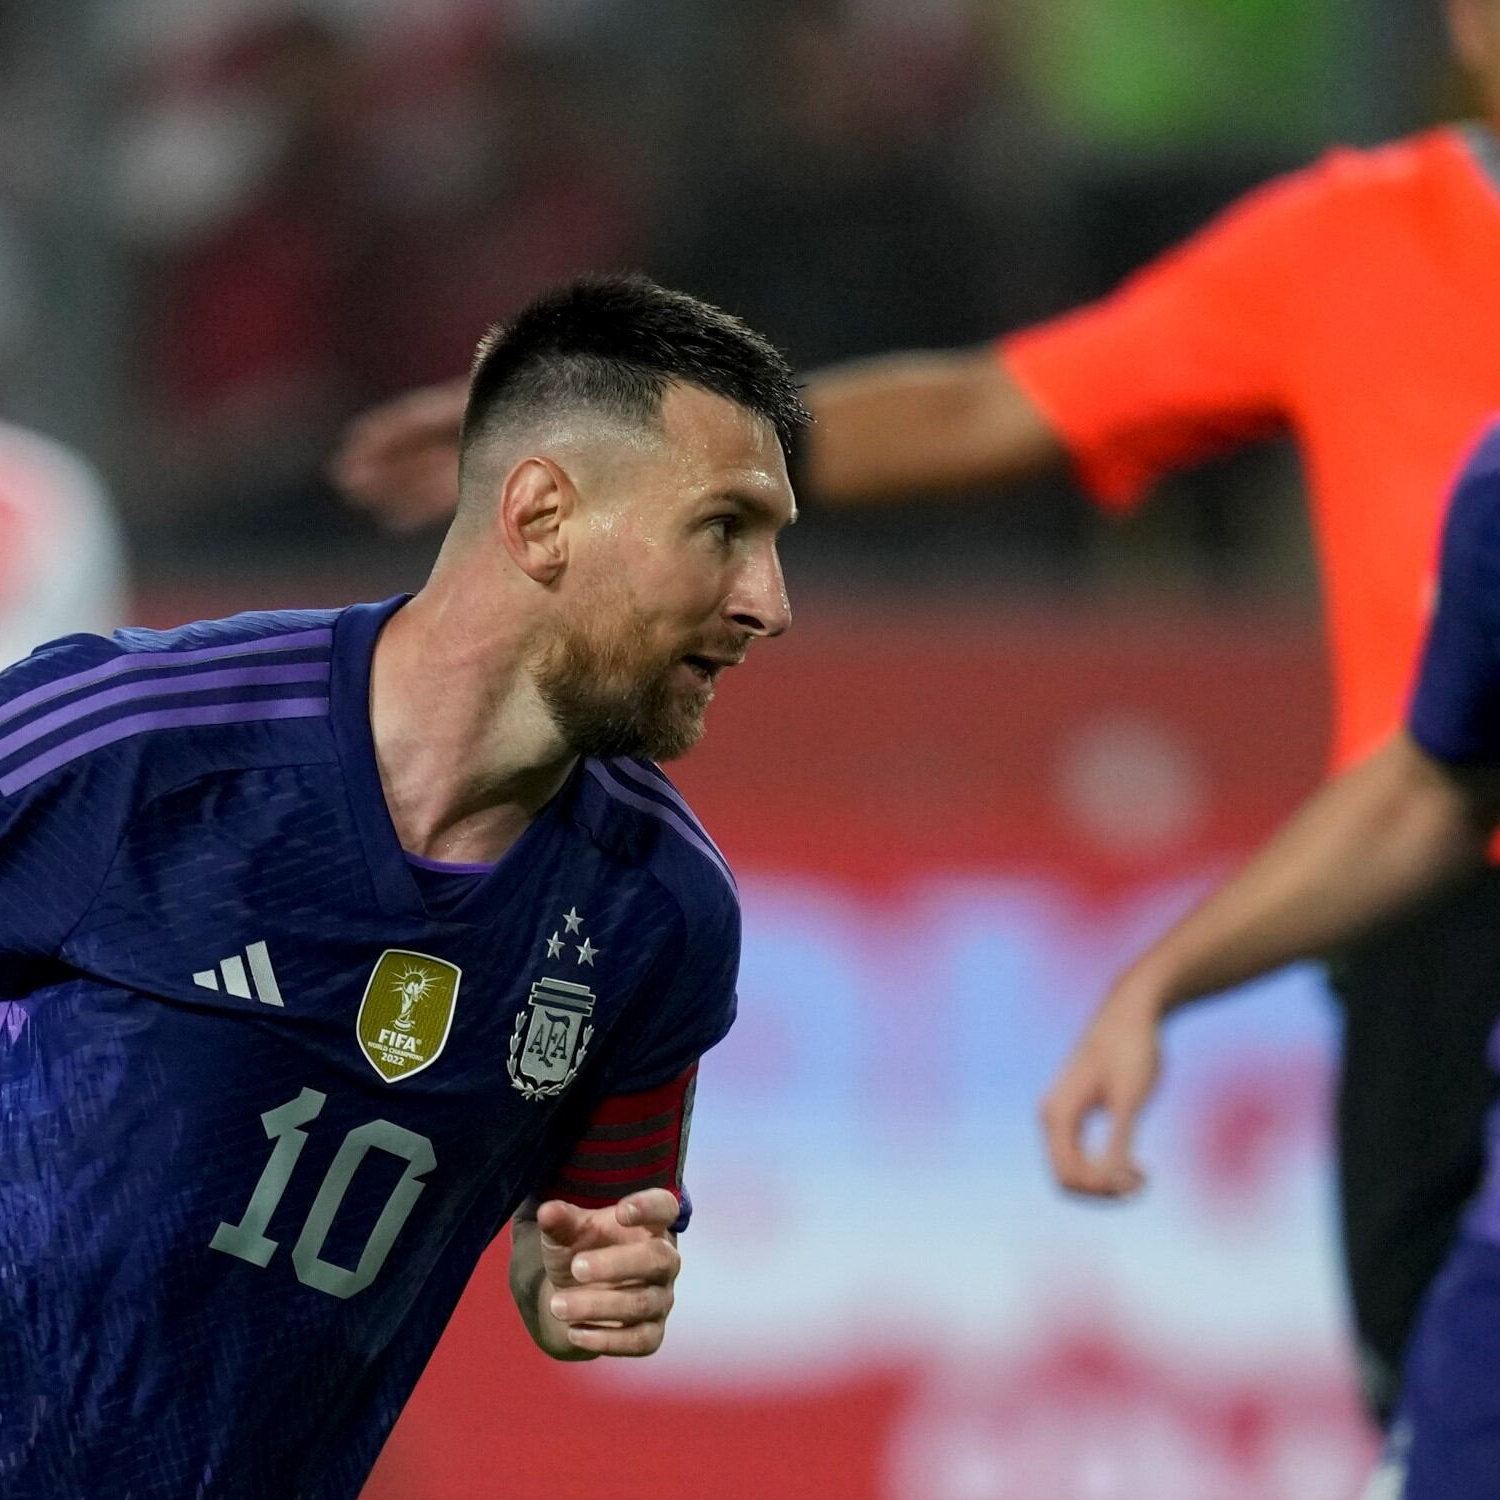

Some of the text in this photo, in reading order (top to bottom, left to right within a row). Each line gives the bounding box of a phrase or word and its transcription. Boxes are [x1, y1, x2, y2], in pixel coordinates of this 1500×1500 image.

[378, 1028, 417, 1053] FIFA
[381, 1052, 405, 1066] 2022
[527, 1010, 570, 1068] AFA
[208, 1086, 438, 1300] 10
